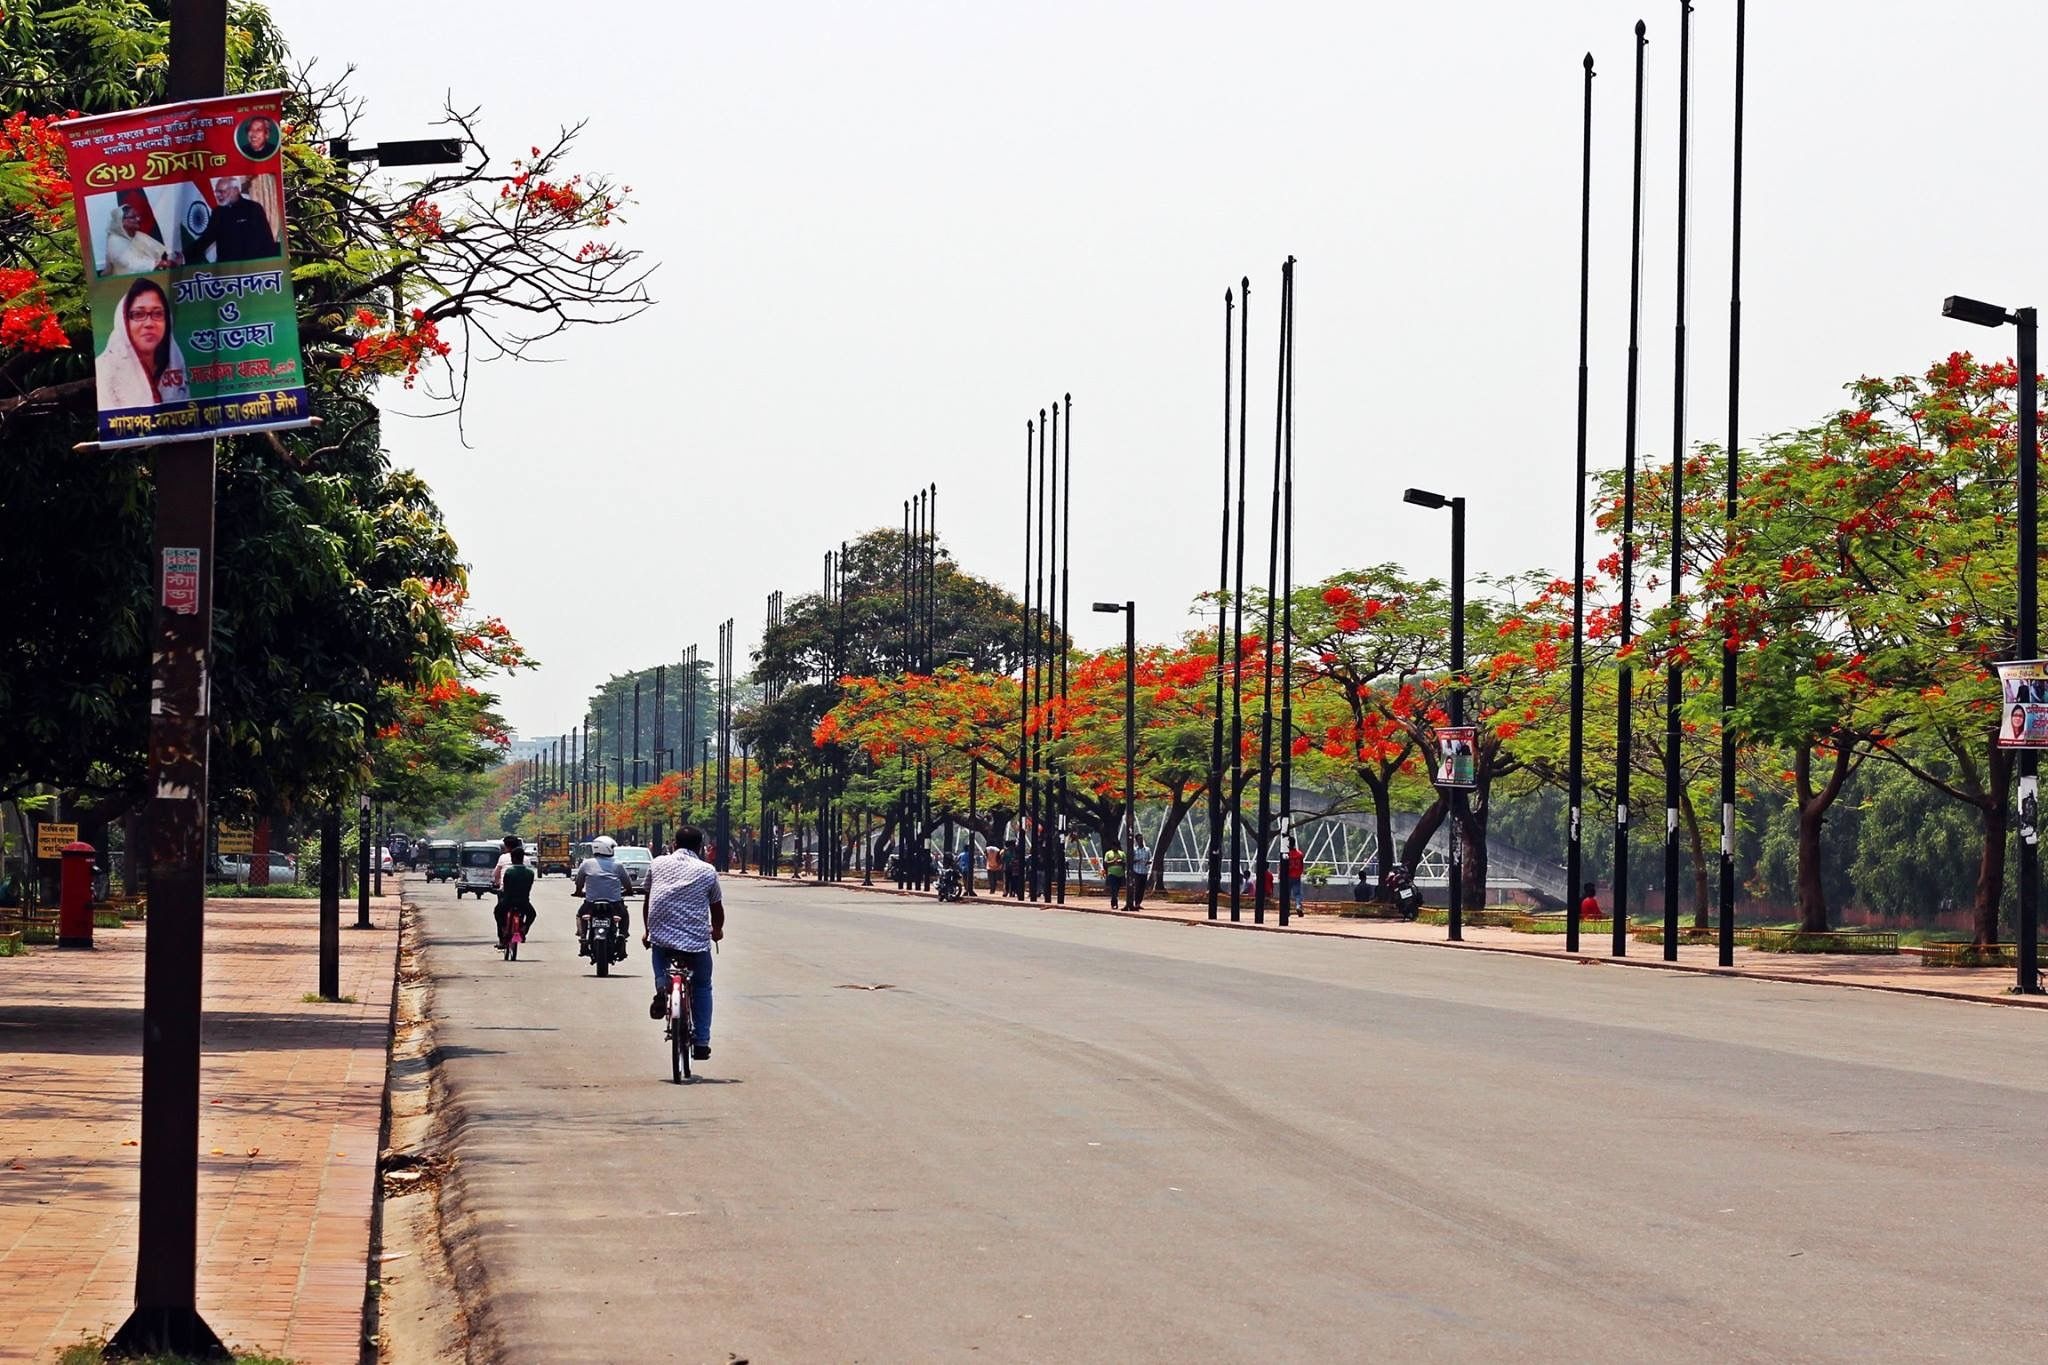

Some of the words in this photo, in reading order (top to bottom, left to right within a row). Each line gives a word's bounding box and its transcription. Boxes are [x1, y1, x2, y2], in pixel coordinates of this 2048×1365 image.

[93, 134, 114, 144] ভারত
[164, 120, 189, 132] জাতির
[86, 162, 136, 188] শেখ
[141, 151, 213, 182] হাসিনা
[210, 154, 228, 168] কে
[173, 271, 283, 303] অভিনন্দন
[219, 302, 240, 323] ও
[190, 322, 275, 352] শুভেচ্ছা
[225, 393, 273, 424] আওয়ামী
[274, 391, 298, 416] লীগ
[167, 557, 197, 565] HSC
